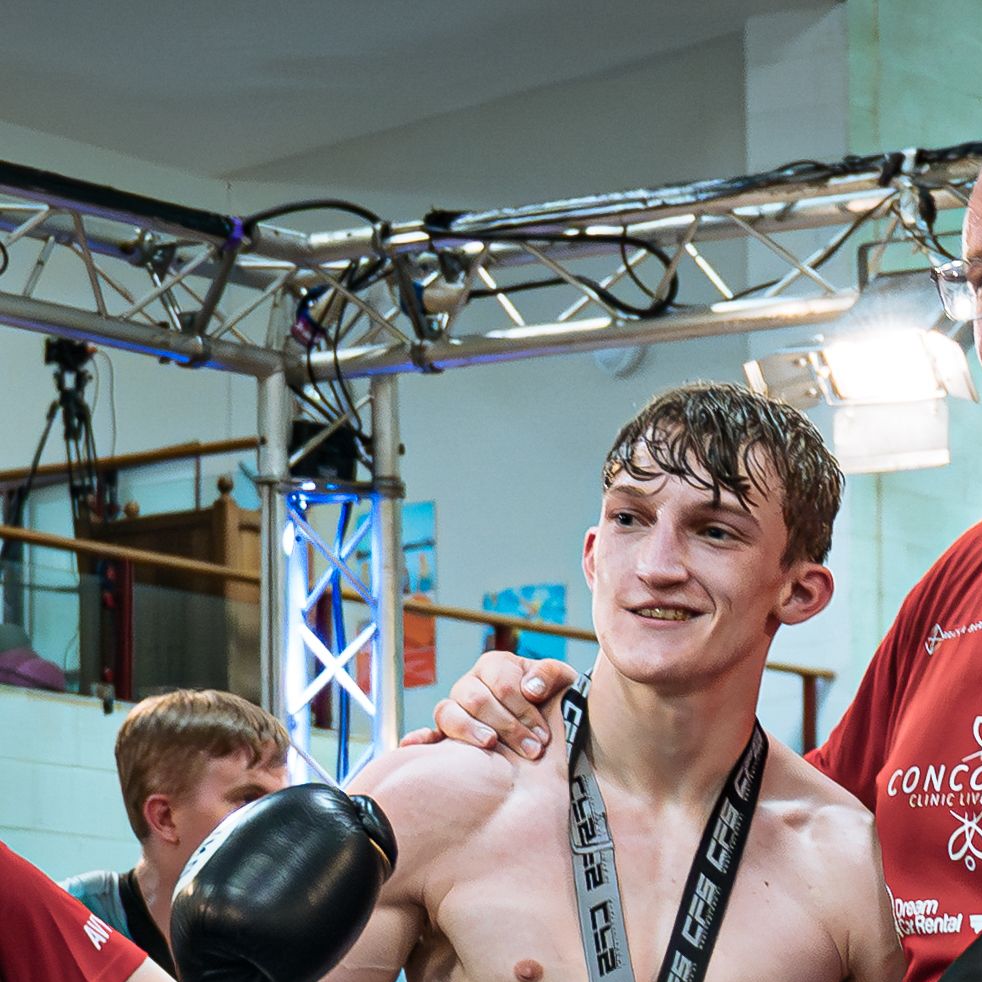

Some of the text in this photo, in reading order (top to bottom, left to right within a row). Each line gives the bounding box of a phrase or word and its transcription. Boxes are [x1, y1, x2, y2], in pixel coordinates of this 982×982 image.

[909, 792, 958, 808] CLINIC
[706, 797, 742, 873] CFS
[681, 872, 718, 949] CFS
[894, 897, 938, 917] Dream
[915, 912, 963, 936] Rental
